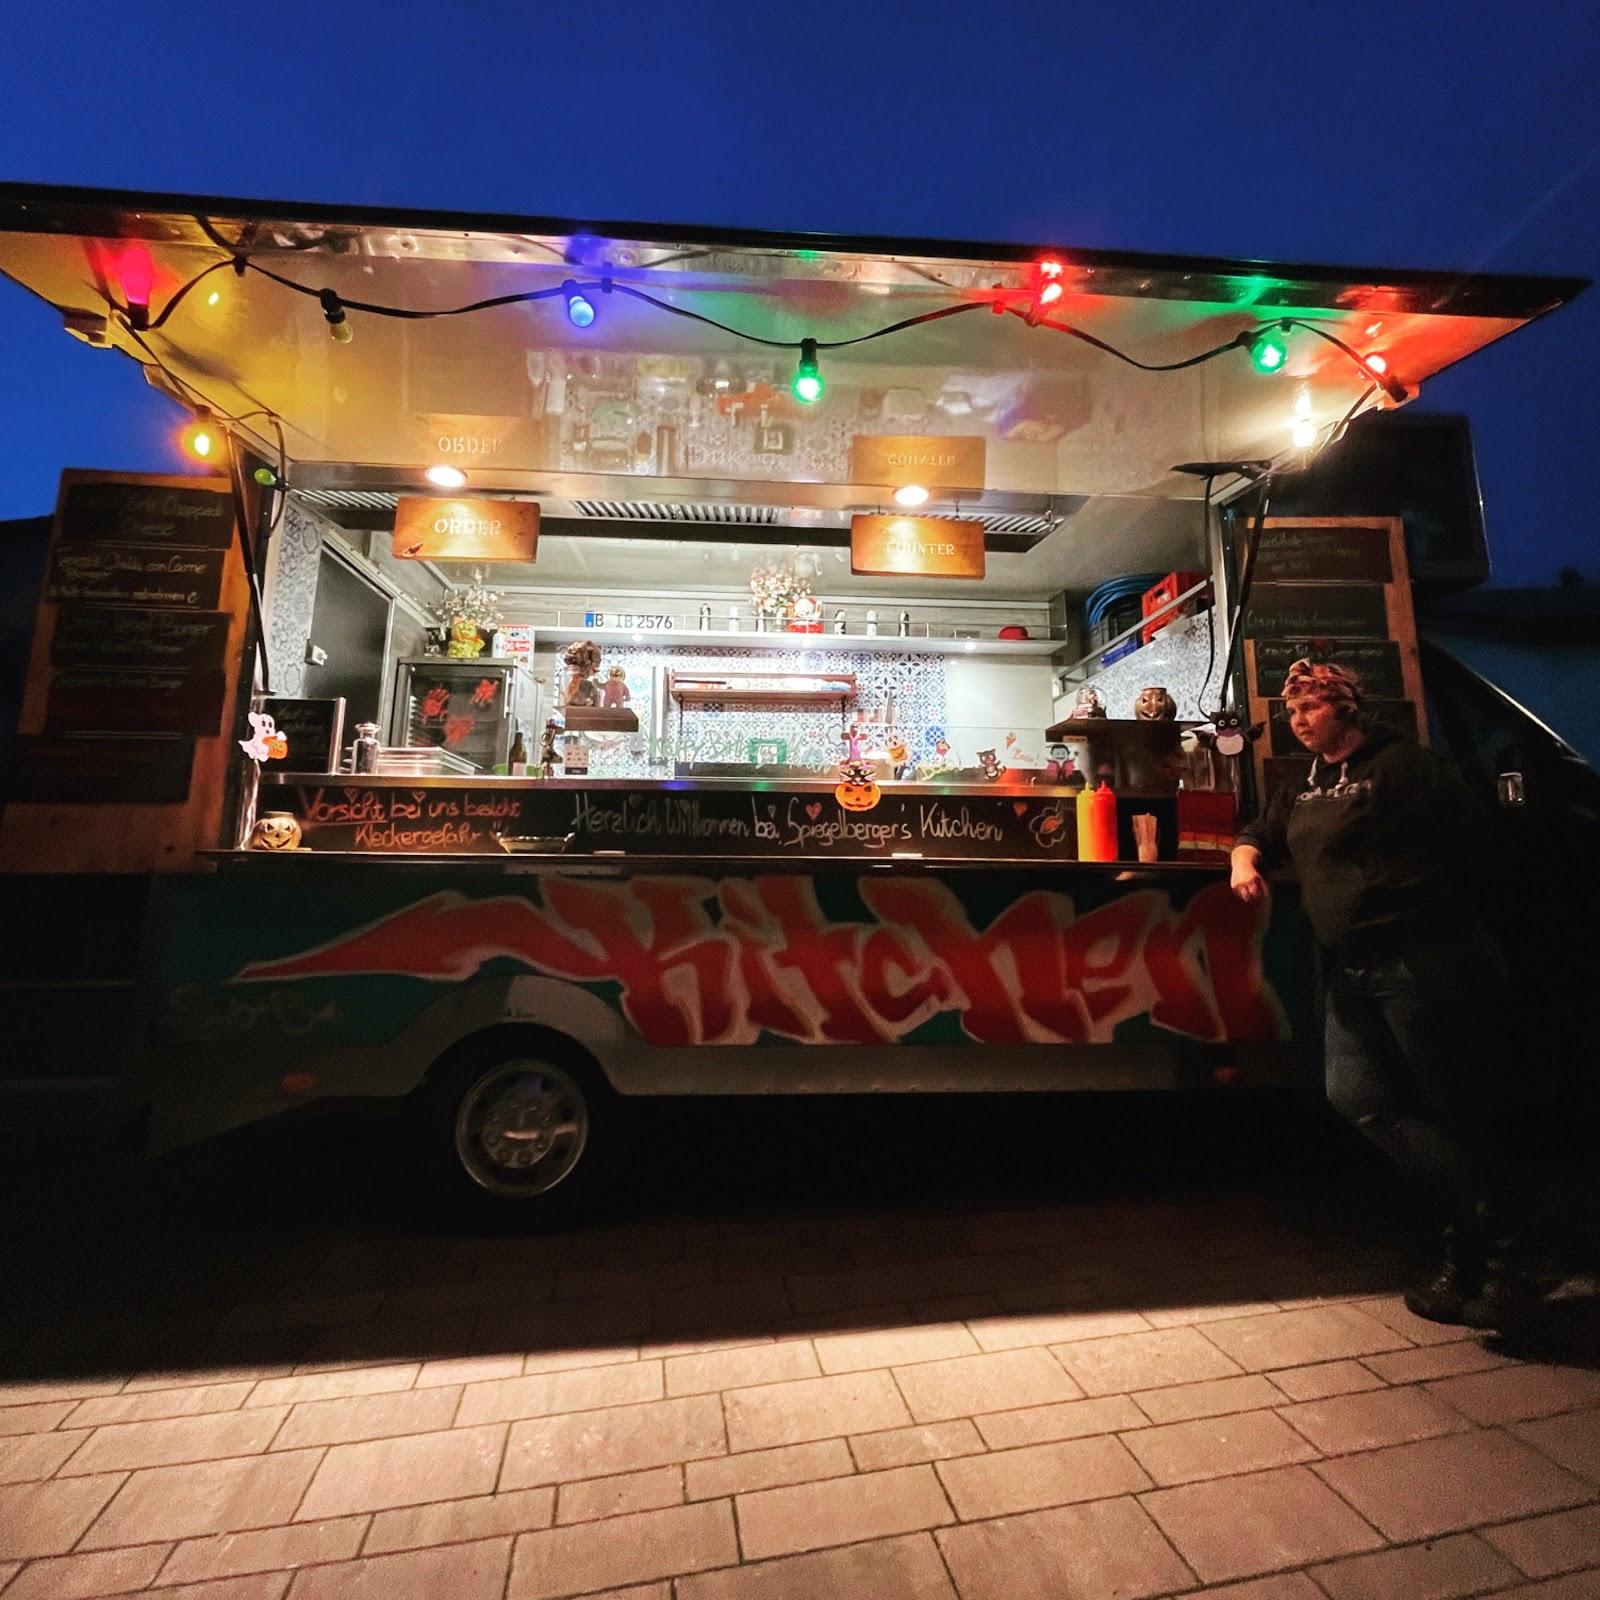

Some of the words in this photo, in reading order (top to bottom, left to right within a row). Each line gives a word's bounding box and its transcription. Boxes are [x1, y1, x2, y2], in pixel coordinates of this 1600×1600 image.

[434, 517, 502, 536] ORDER
[886, 541, 955, 555] COUNTER
[637, 615, 673, 629] 2576
[391, 790, 426, 819] bei
[428, 801, 460, 818] uns
[570, 791, 662, 835] Herzlich
[920, 802, 1004, 843] Kitchen
